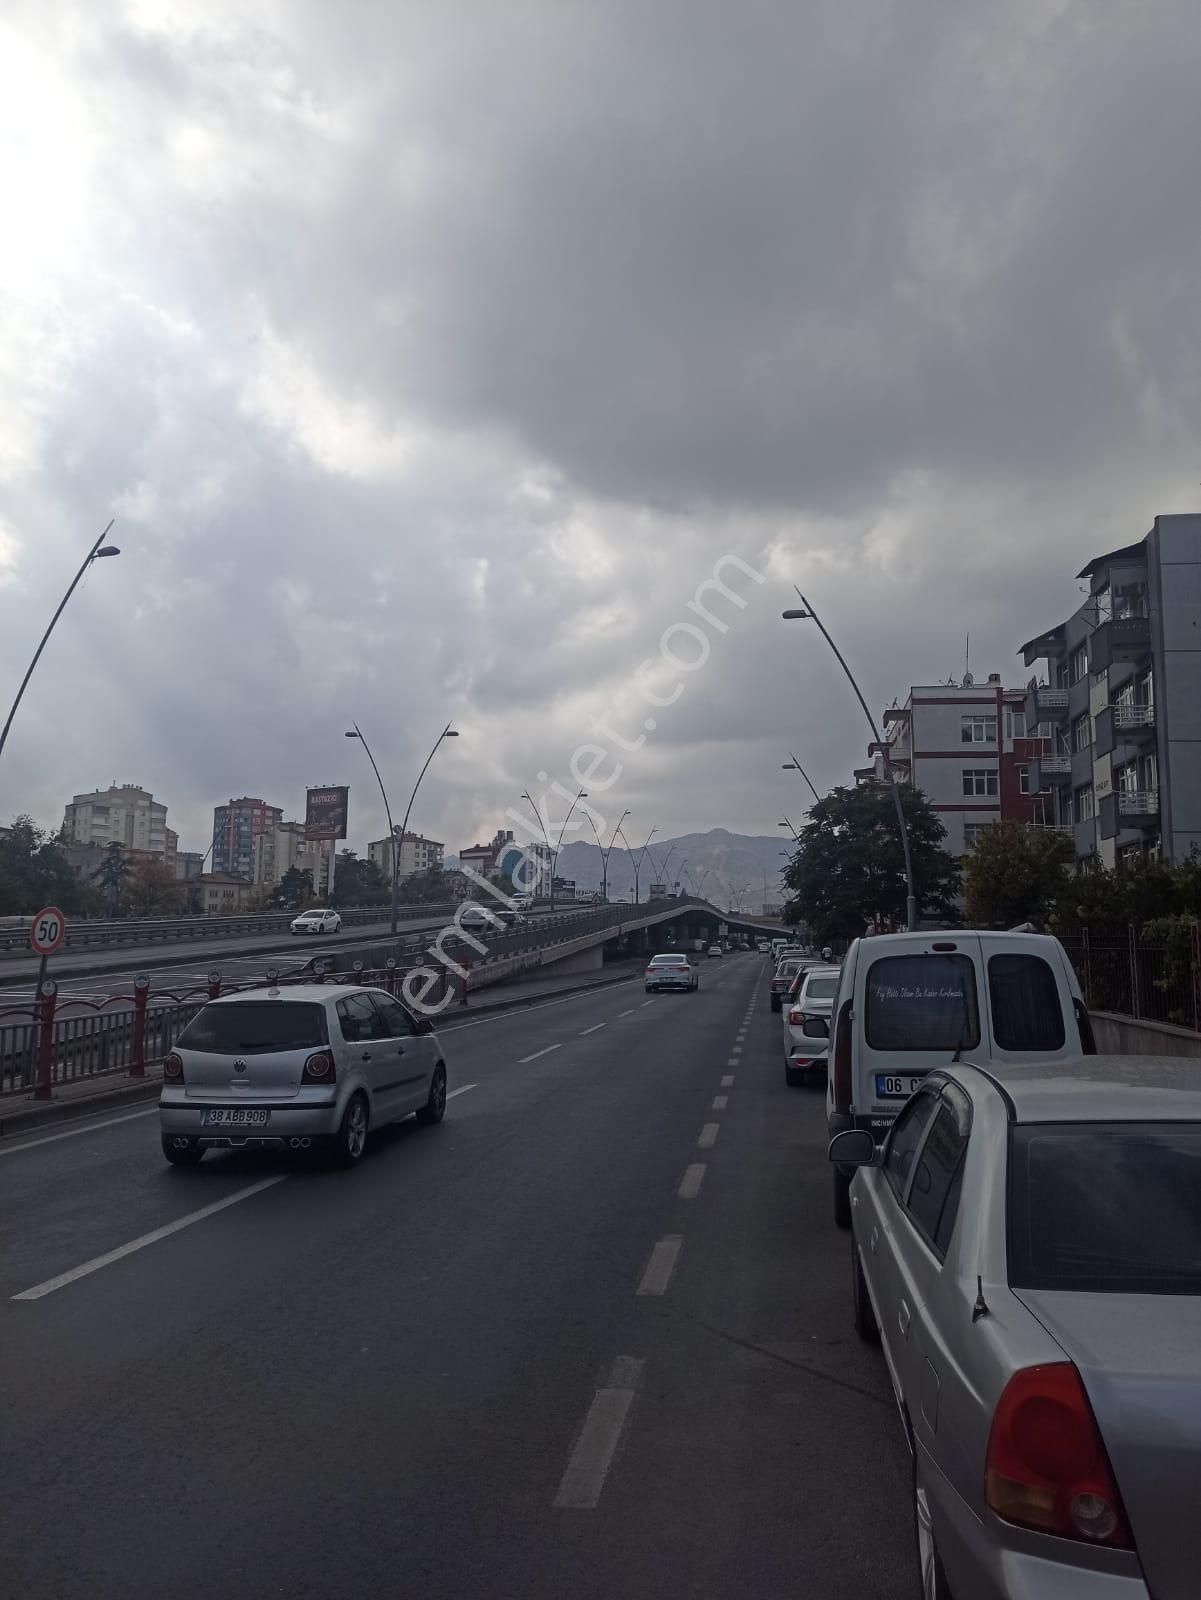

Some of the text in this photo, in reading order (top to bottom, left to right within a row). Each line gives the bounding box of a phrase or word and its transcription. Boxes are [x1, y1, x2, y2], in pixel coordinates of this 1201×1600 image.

[38, 921, 58, 942] 50
[887, 1078, 902, 1092] 06
[210, 1111, 223, 1121] 38
